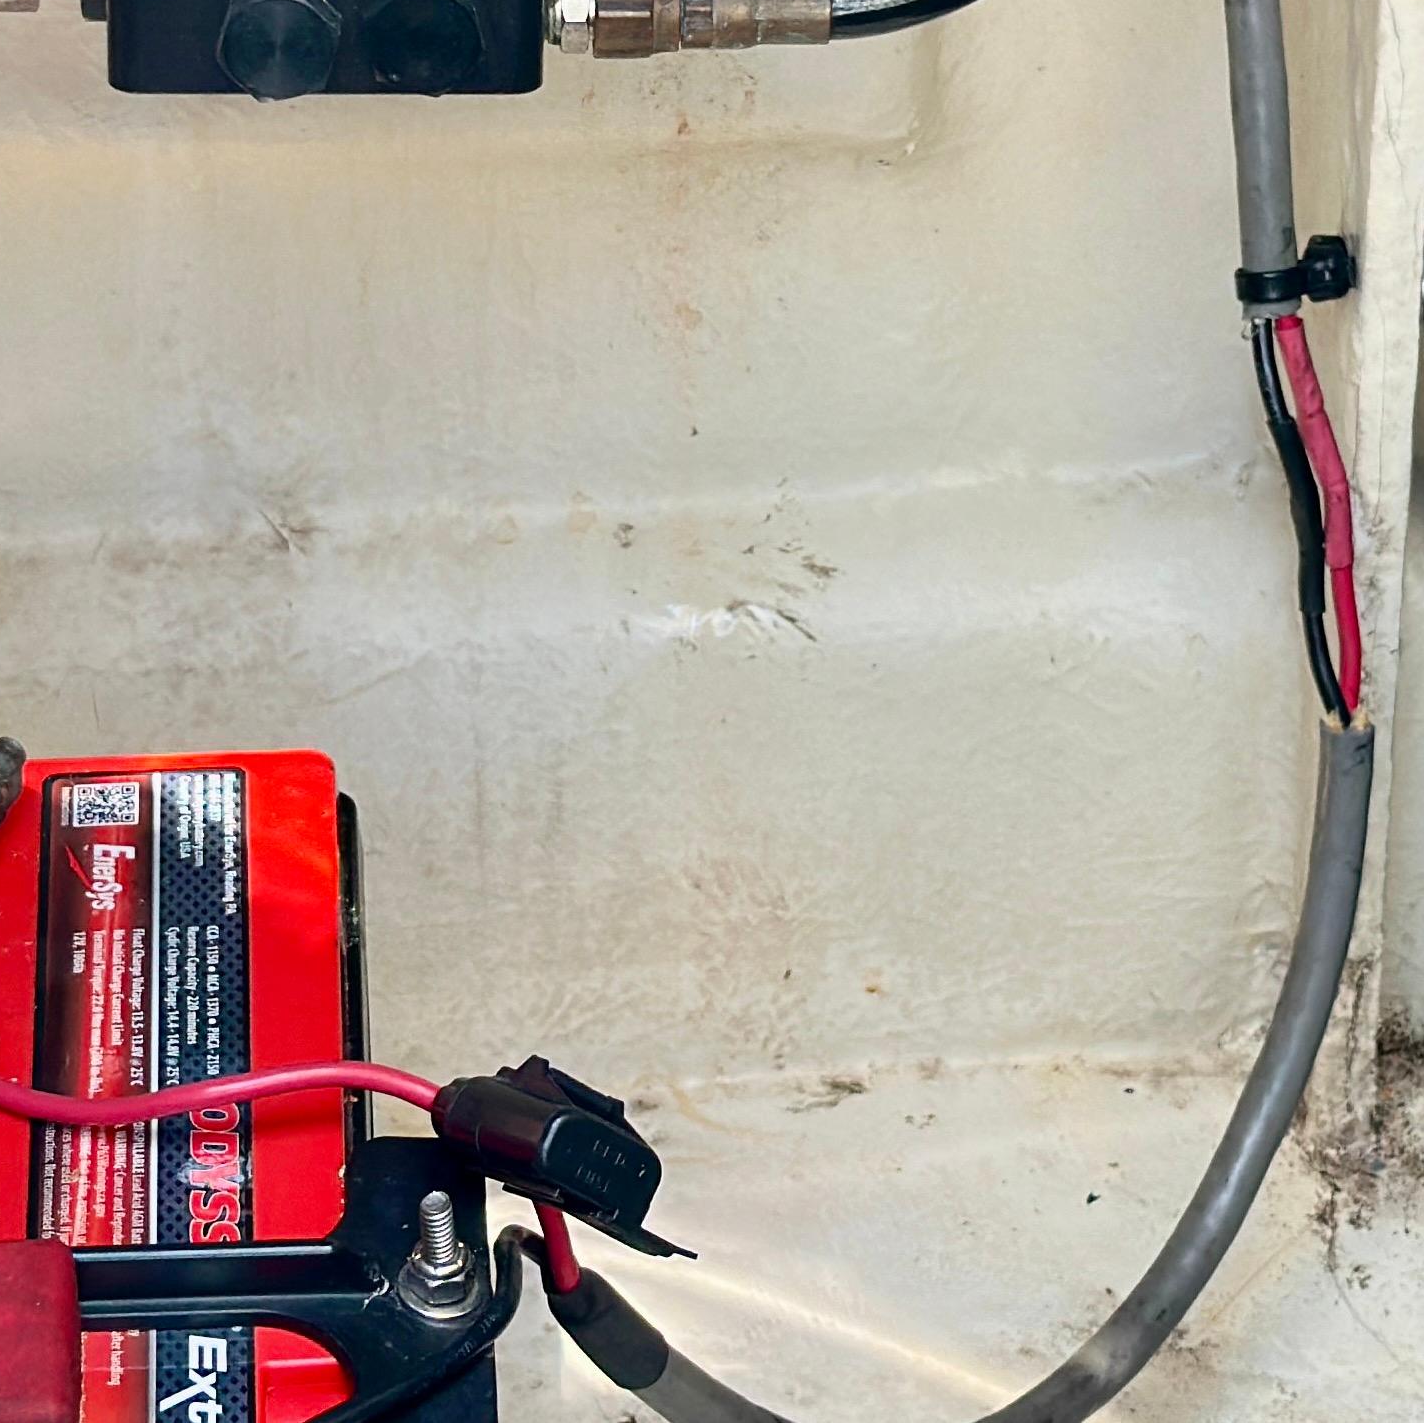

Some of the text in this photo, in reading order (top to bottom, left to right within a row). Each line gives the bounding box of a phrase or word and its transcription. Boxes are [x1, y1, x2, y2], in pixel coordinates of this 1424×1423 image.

[180, 842, 191, 859] USA
[85, 843, 136, 910] EnerSys
[225, 903, 237, 915] PA
[132, 928, 145, 948] Float
[164, 927, 180, 947] Cyclic
[207, 926, 219, 939] CCA
[129, 950, 145, 976] Charge
[165, 949, 180, 976] Charge
[207, 946, 219, 964] 1150
[109, 929, 125, 1045] No Initial Charge Current Limit
[164, 976, 180, 1009] Voltage:
[184, 926, 200, 1044] Reserve Capacity 220 minutes
[207, 975, 219, 991] MCA
[129, 977, 145, 1010] Voltage:
[207, 998, 219, 1016] 1370
[131, 1011, 144, 1028] 13.5
[167, 1011, 179, 1028] 14.4
[207, 1027, 219, 1049] PHCA
[43, 1164, 56, 1229] Not recommended
[132, 1193, 144, 1208] Acid
